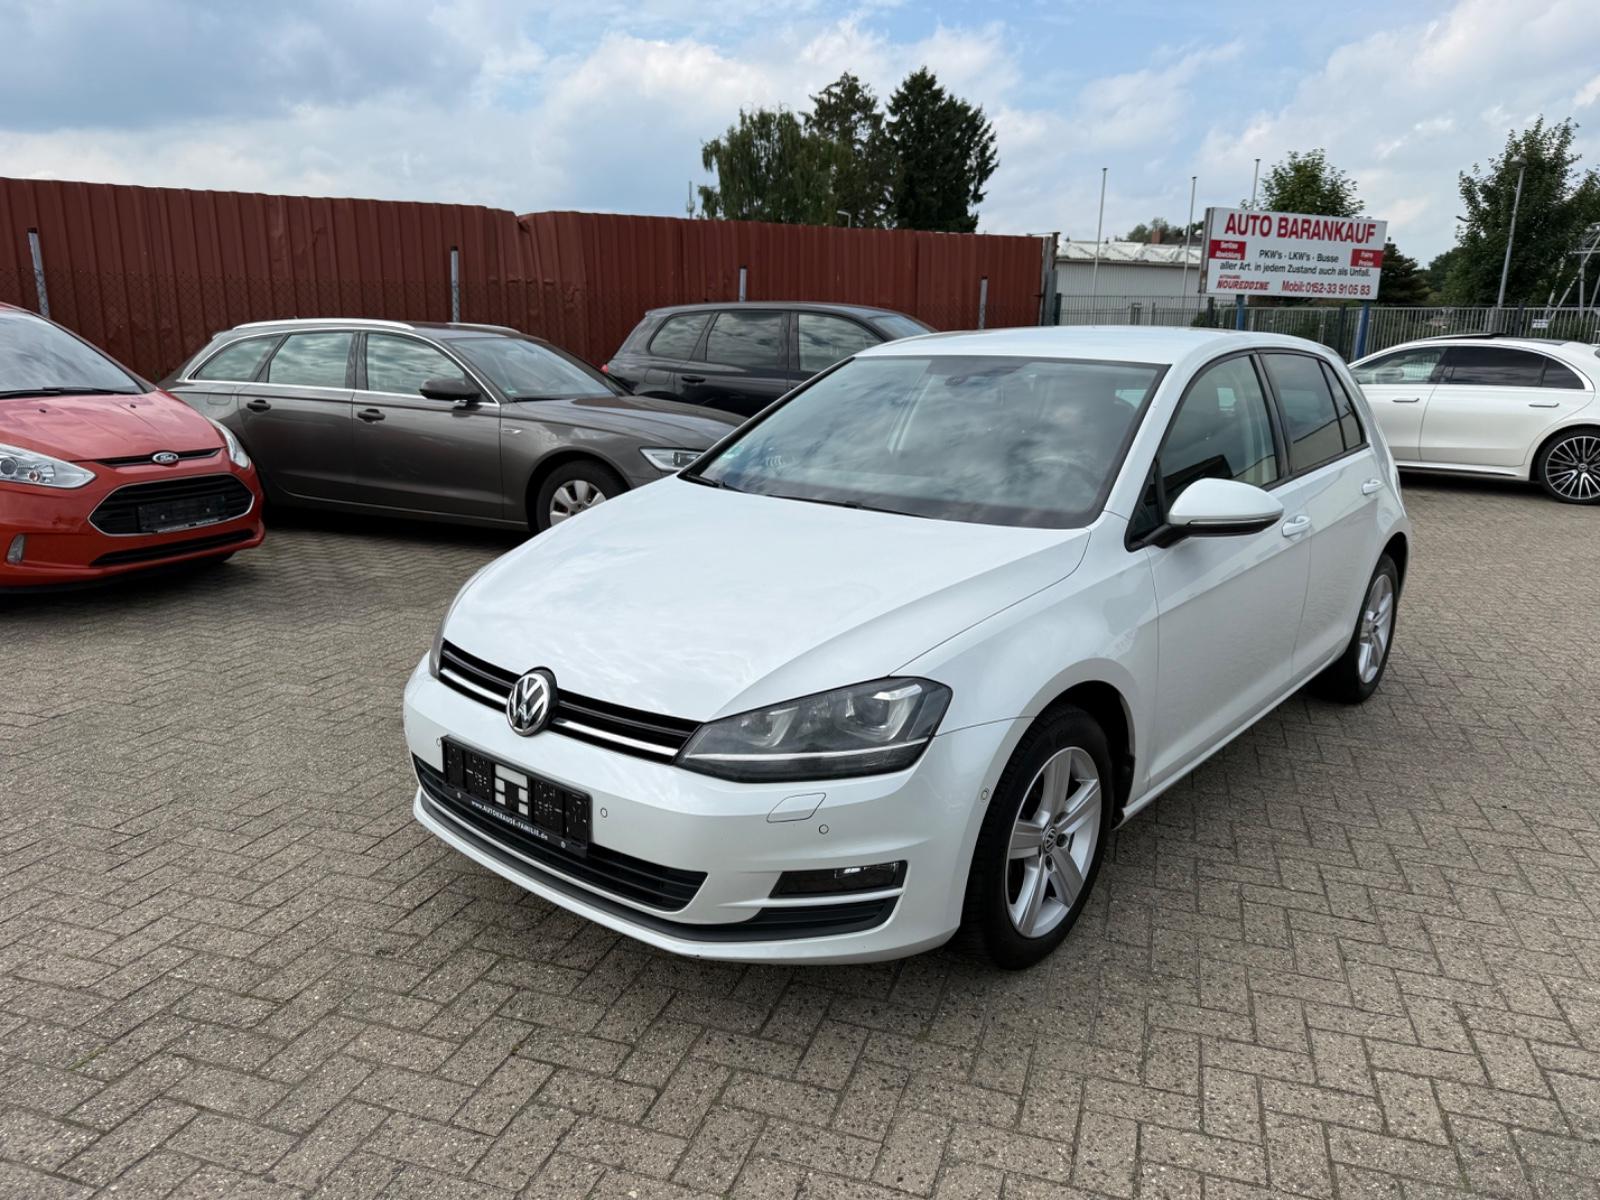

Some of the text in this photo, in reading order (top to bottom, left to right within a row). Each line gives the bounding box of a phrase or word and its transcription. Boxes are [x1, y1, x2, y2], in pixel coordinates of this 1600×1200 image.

[1224, 213, 1377, 244] AUTO BARANKAUF
[1259, 249, 1339, 263] PKW's LKW's Busse
[1220, 261, 1238, 271] aller
[1254, 263, 1262, 272] in
[1262, 263, 1286, 274] jedem
[1287, 264, 1317, 274] Zustand
[1318, 267, 1336, 276] auch
[1337, 267, 1348, 276] als
